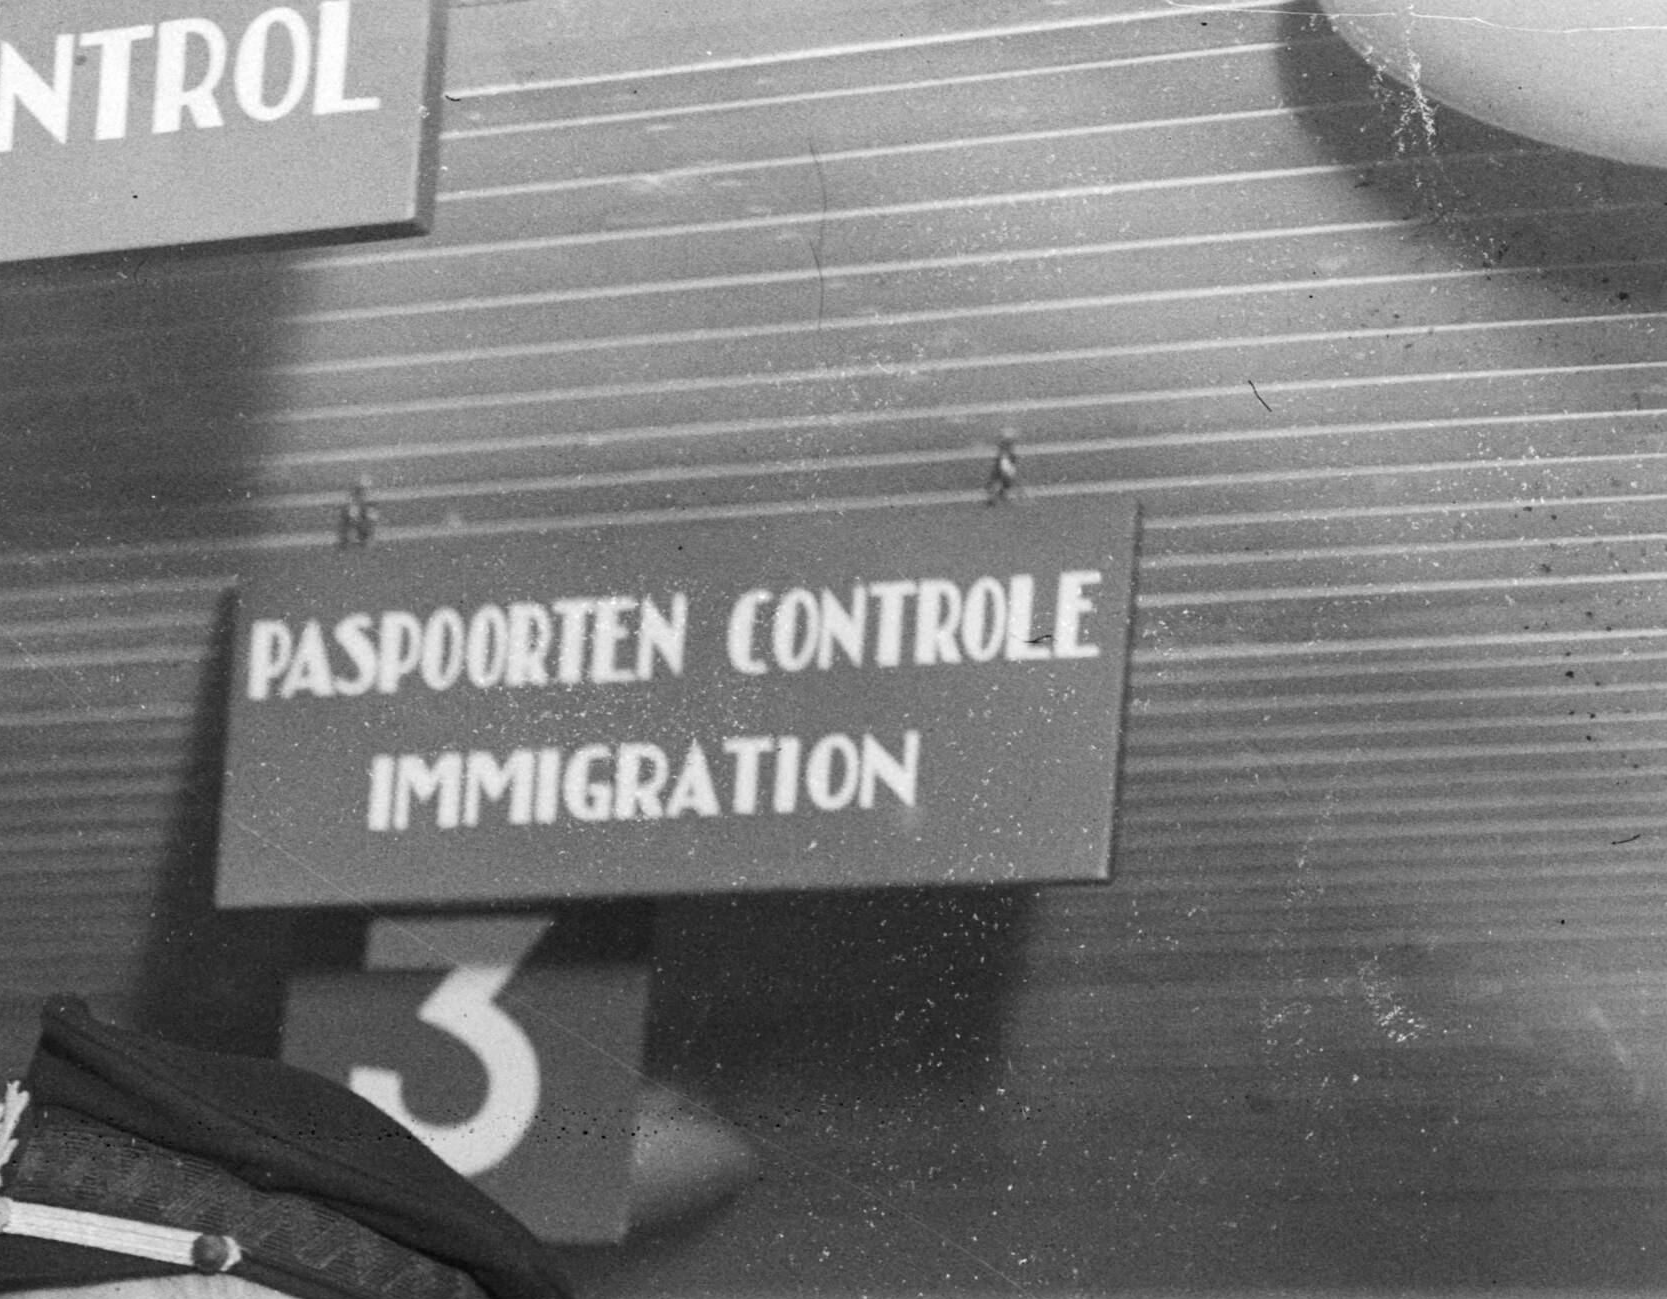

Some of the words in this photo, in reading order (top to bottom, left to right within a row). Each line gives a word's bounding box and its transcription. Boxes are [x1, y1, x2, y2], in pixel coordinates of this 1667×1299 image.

[246, 594, 689, 700] PASPOORTEN
[725, 569, 1104, 676] CONTROLE
[366, 729, 922, 832] IMMIGRATION
[349, 915, 554, 1177] 3
